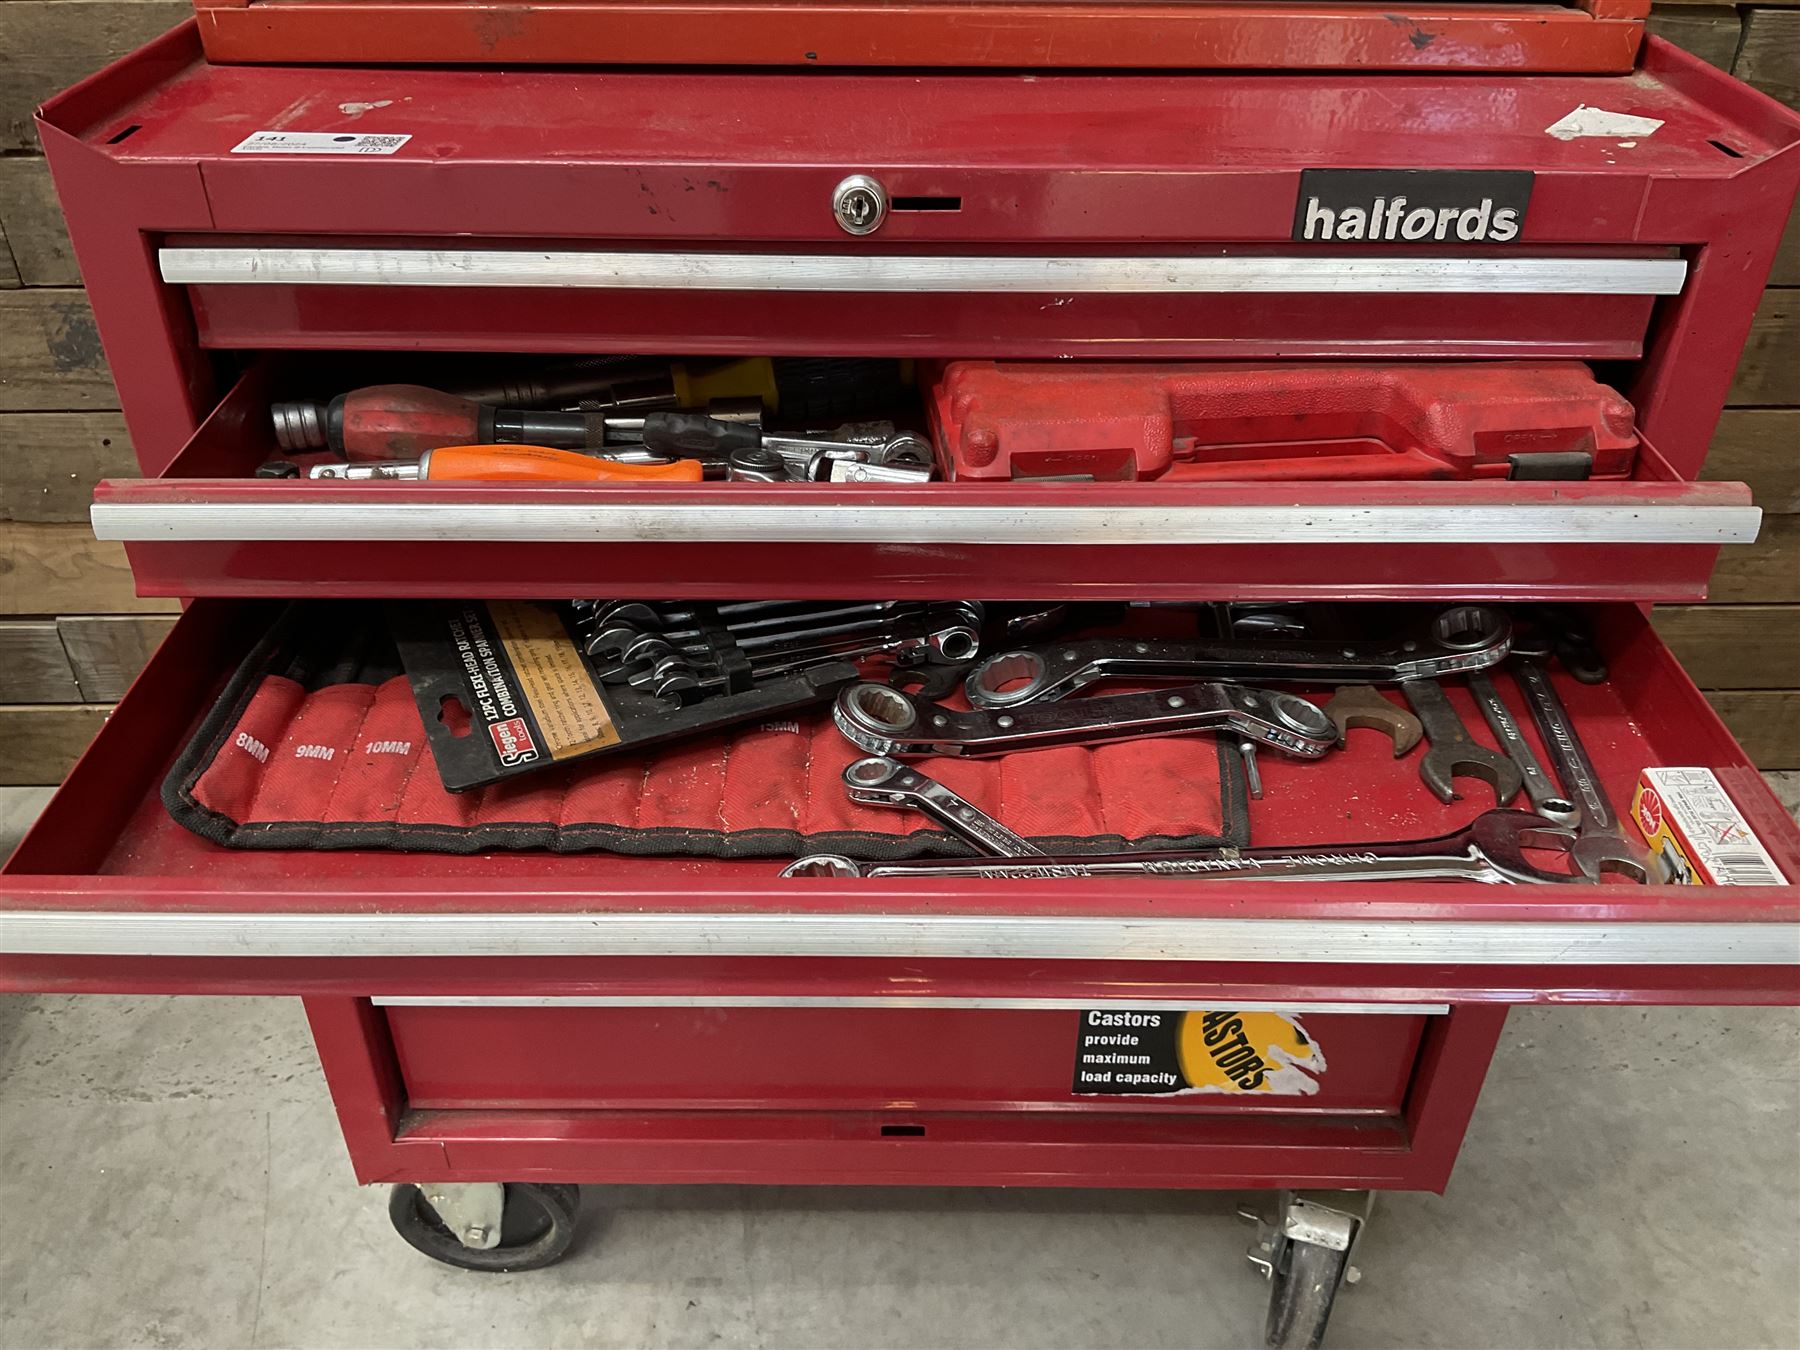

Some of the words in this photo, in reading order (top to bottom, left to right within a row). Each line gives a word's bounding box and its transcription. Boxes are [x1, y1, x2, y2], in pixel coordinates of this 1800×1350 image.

[1303, 196, 1519, 242] halfords
[448, 618, 471, 652] RATCHET
[469, 622, 492, 657] SPANNER
[462, 651, 490, 698] FLEXI-HEAD
[483, 656, 517, 717] COMBINATION
[479, 696, 499, 721] 12PC
[513, 720, 527, 741] tools
[235, 732, 270, 764] 8MM
[295, 744, 335, 761] 9MM
[365, 741, 412, 756] 10MM
[497, 722, 539, 767] Siegen
[1641, 804, 1655, 831] NGK
[1088, 1011, 1161, 1027] Castors
[1084, 1034, 1139, 1047] provide
[1201, 1011, 1273, 1090] ASTORS
[1082, 1053, 1151, 1065] maximum
[1081, 1071, 1115, 1083] load
[1116, 1072, 1177, 1086] capacity
